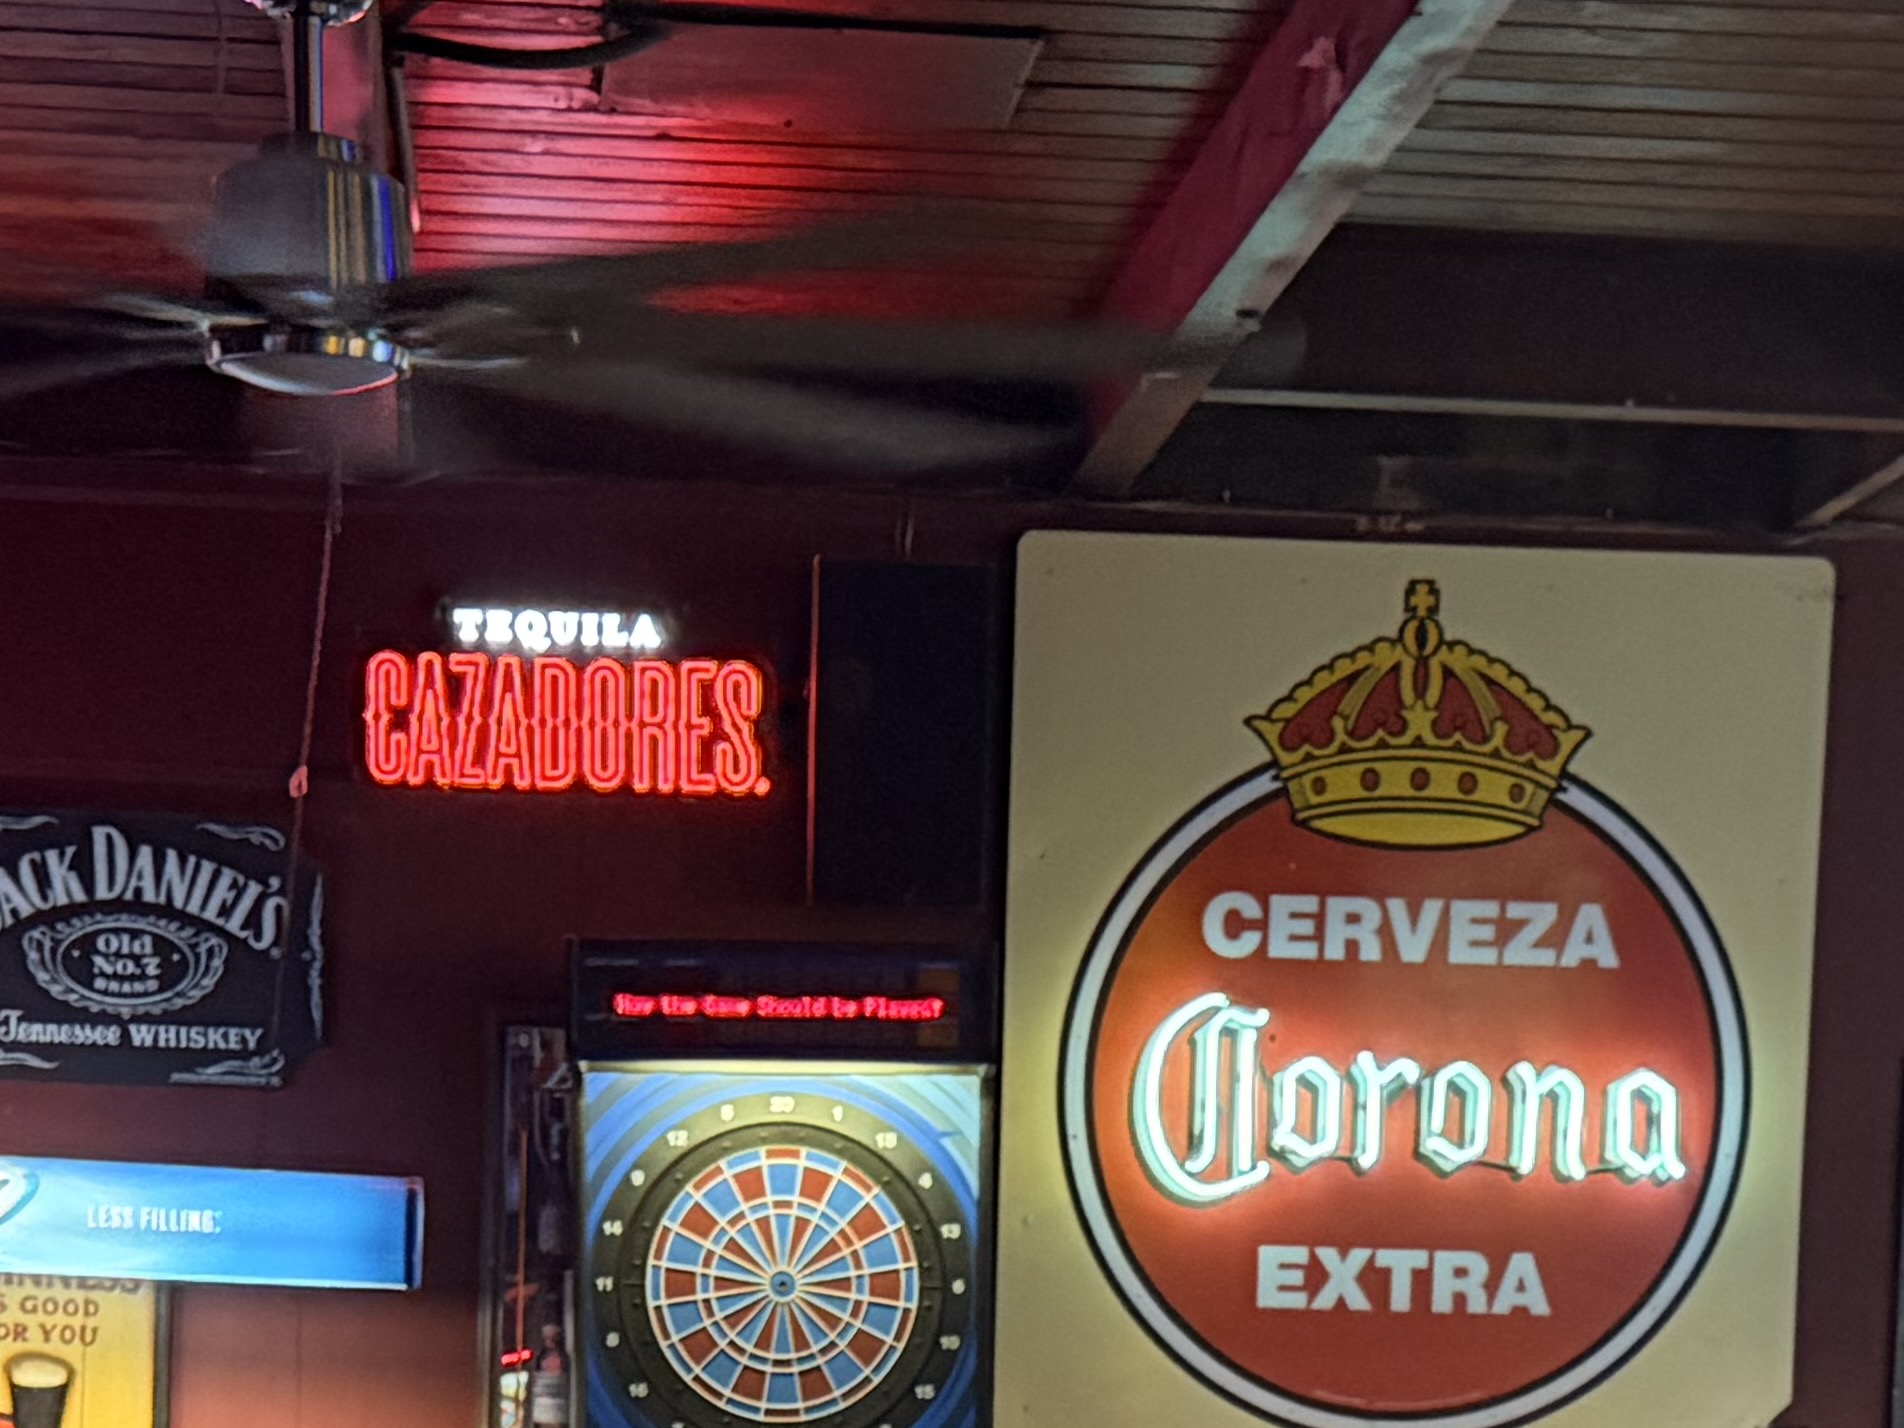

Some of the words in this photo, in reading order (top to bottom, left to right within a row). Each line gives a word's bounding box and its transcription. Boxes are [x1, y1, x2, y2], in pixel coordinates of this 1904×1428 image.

[451, 607, 662, 650] TEQUILA
[90, 824, 290, 960] DANIEL'S
[97, 934, 154, 957] Old
[1201, 890, 1621, 969] CERVEZA
[129, 1022, 264, 1051] WHISKEY
[1130, 988, 1688, 1206] Corona
[87, 1209, 134, 1229] LESS
[1256, 1244, 1551, 1316] EXTRA
[19, 1296, 100, 1318] GOOD
[38, 1323, 99, 1347] YOU
